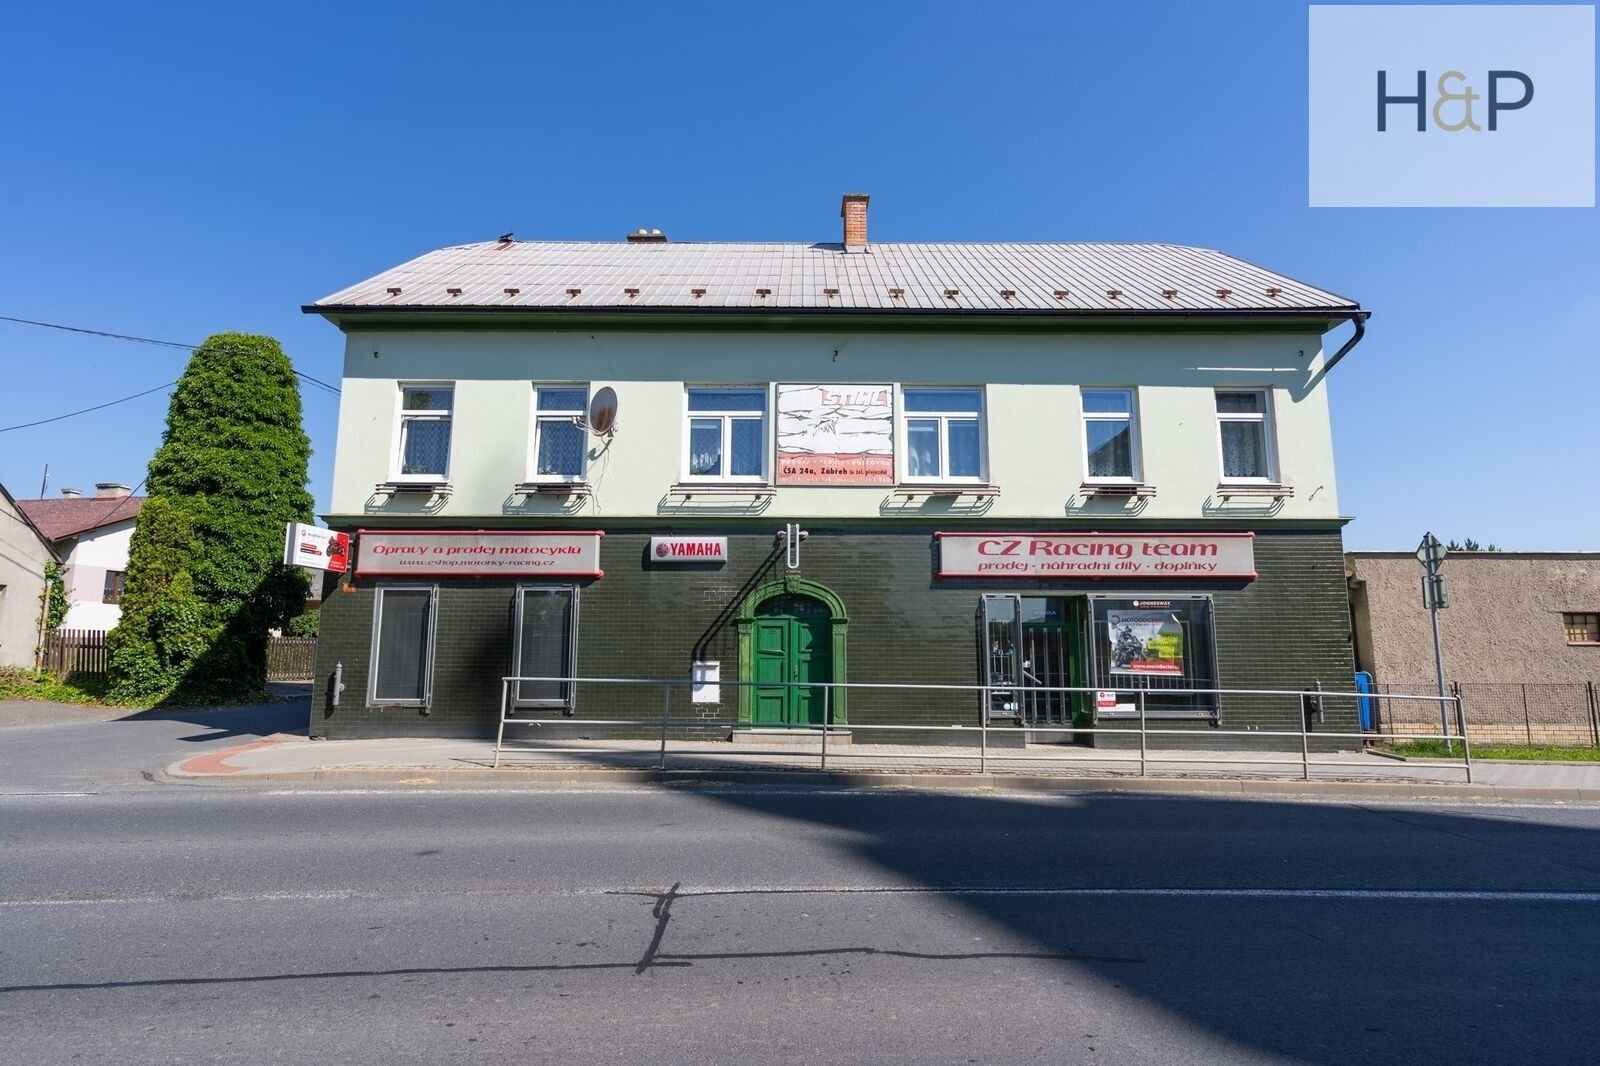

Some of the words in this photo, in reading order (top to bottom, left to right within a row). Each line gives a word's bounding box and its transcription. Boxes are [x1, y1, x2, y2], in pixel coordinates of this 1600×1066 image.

[783, 465, 797, 475] ČSA
[799, 466, 817, 476] 24a,
[820, 466, 848, 475] Zábřeh
[372, 545, 429, 556] Opravy
[433, 546, 443, 555] a
[446, 545, 496, 556] prodej
[670, 542, 721, 556] YAMAHA
[977, 540, 1022, 556] CZ
[1028, 540, 1133, 560] Racing
[1141, 541, 1218, 556] team
[399, 559, 556, 567] www.eshop.motorky-racing.cz
[977, 561, 1029, 572] prodej
[1040, 561, 1111, 571] náhradní
[1114, 561, 1142, 572] díly
[1155, 561, 1218, 572] doplňky
